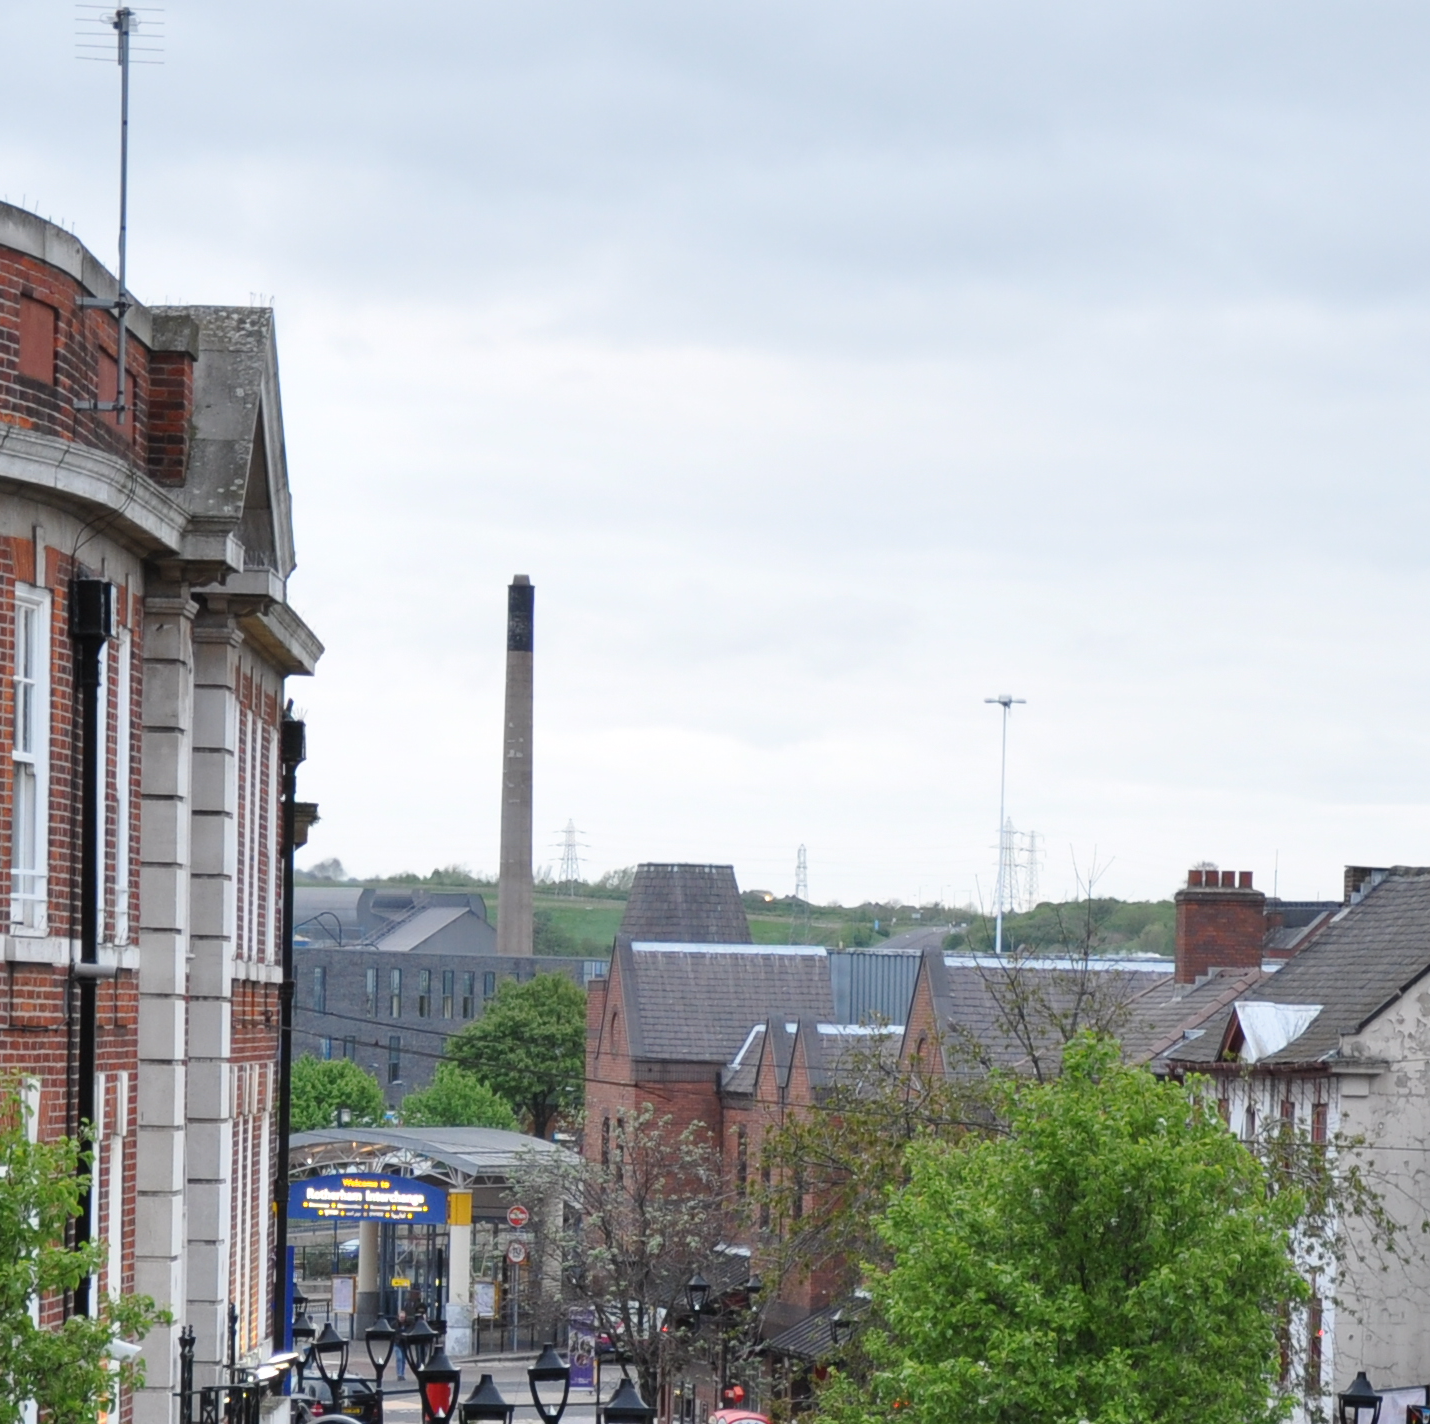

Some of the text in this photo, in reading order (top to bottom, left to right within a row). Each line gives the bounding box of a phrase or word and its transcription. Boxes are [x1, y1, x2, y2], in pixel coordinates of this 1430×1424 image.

[342, 1178, 390, 1189] Welcome to
[306, 1187, 363, 1201] Rotherham
[365, 1190, 425, 1206] Interchange
